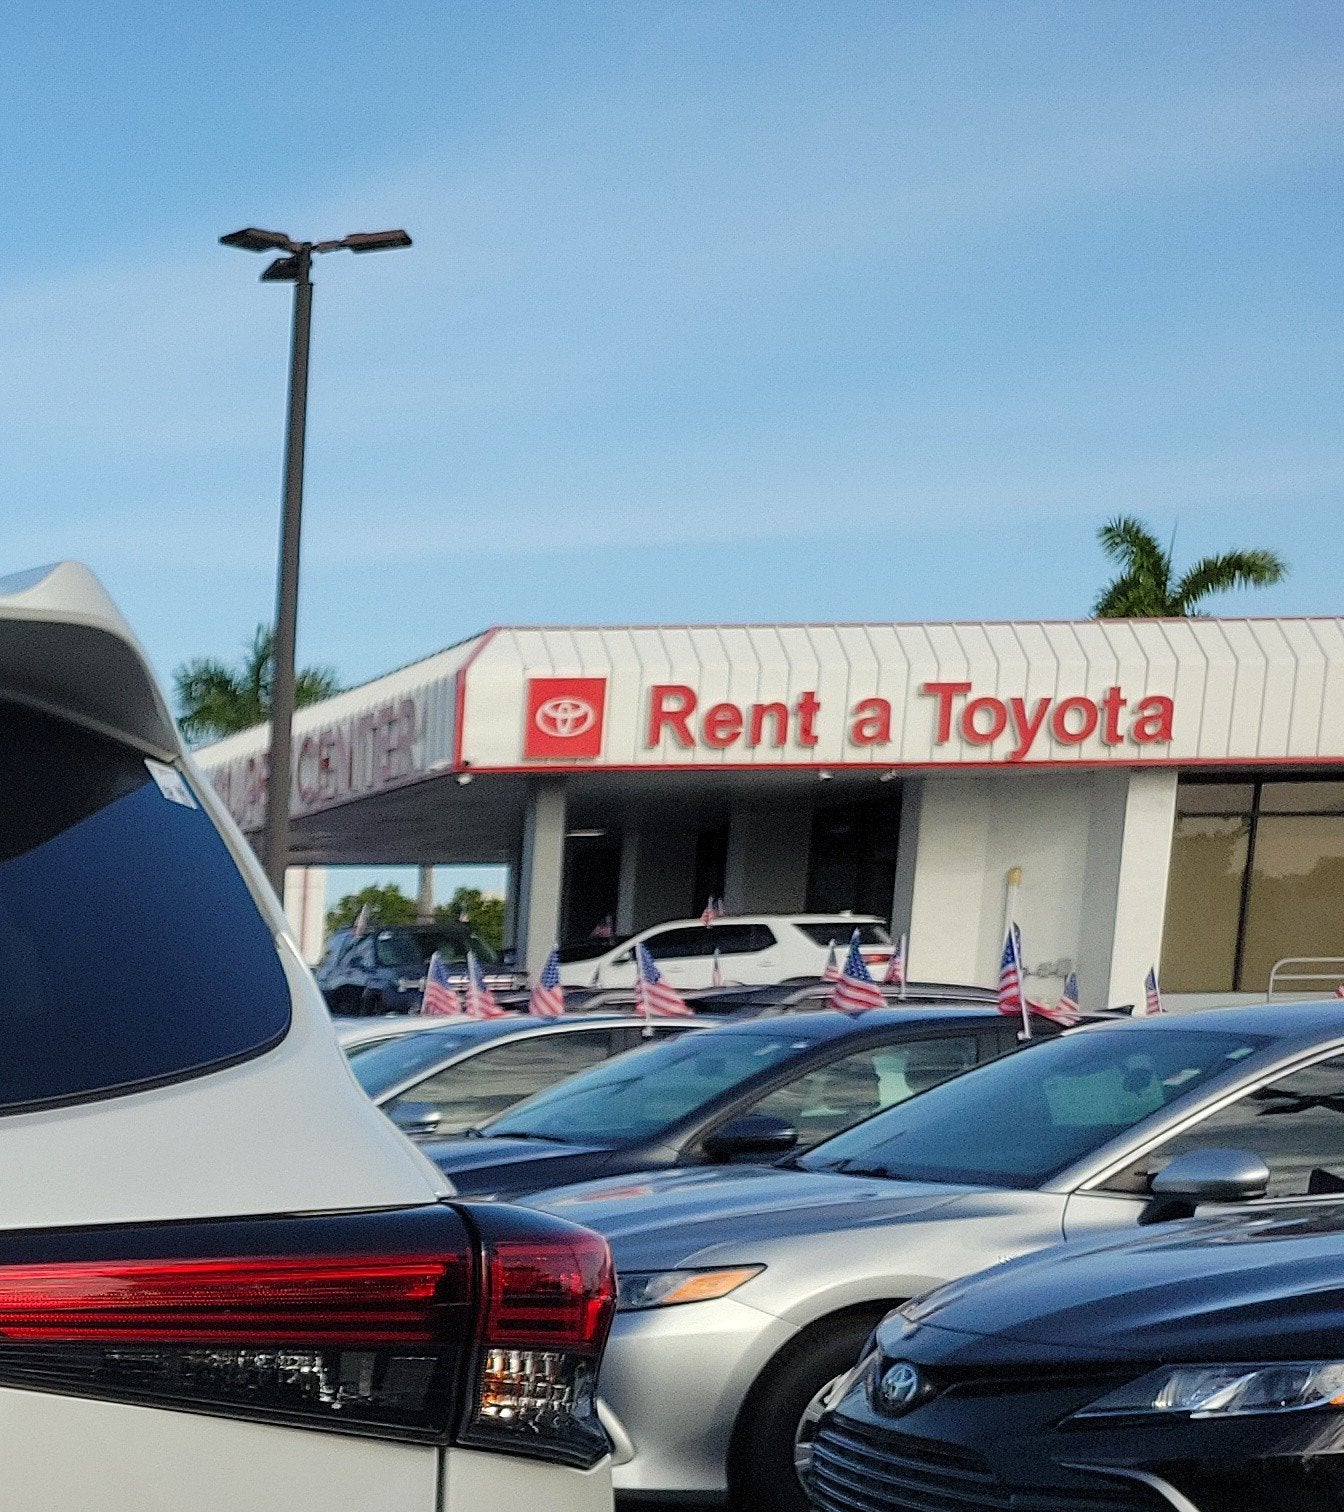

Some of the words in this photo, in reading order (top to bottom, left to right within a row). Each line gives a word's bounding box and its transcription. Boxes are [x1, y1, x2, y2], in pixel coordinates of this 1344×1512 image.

[647, 684, 819, 748] Rent
[849, 697, 893, 748] a
[922, 681, 1176, 761] Toyota
